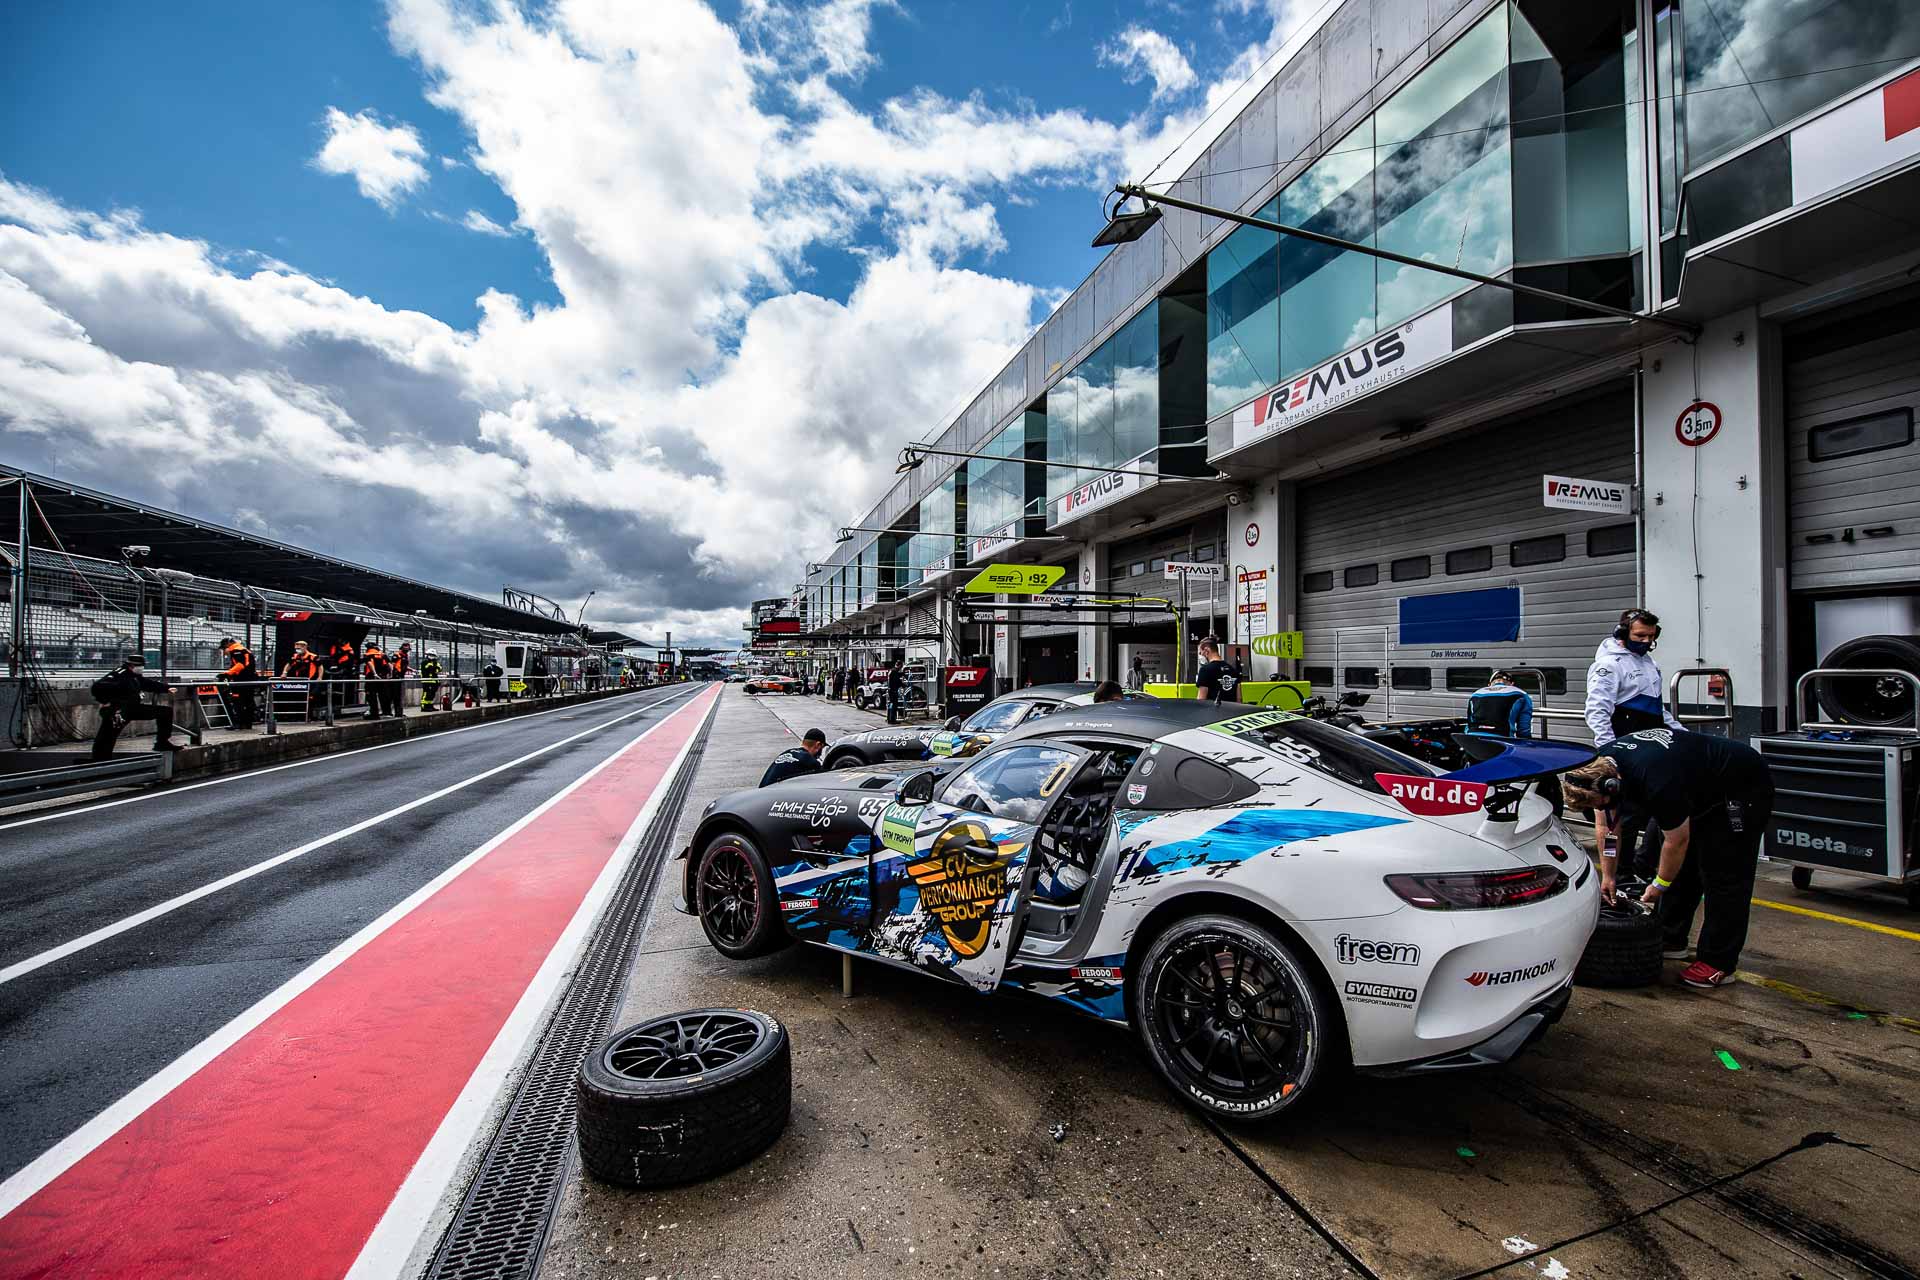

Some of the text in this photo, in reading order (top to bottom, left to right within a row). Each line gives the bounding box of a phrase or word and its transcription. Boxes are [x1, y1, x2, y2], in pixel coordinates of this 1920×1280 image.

[1267, 332, 1405, 420] REMUS
[1266, 365, 1406, 432] PERFORMANCE SPORT EXHAUSTS
[1072, 472, 1124, 509] REMUS
[1556, 483, 1622, 502] REMUS
[981, 528, 1008, 552] REMUS
[1430, 650, 1477, 659] Das Werkzeug
[869, 669, 889, 680] ABT
[948, 670, 978, 684] ABT
[1222, 716, 1263, 733] DTM
[1269, 737, 1321, 764] 85
[1391, 781, 1478, 806] avd.de
[770, 801, 848, 816] HMH SHOP
[858, 798, 888, 817] 85
[887, 804, 921, 823] DEKRA
[883, 829, 914, 846] DTM TROPHY
[1795, 831, 1847, 854] Beta
[944, 855, 966, 878] CV
[920, 872, 1004, 908] PERFORMANCE
[787, 900, 811, 909] FERODO
[937, 900, 986, 922] GROUP
[1336, 935, 1418, 964] freem
[1080, 968, 1112, 977] FERODO
[1346, 982, 1415, 1000] SYNGENTO
[1346, 996, 1413, 1009] MOTORSPORTMARKETING
